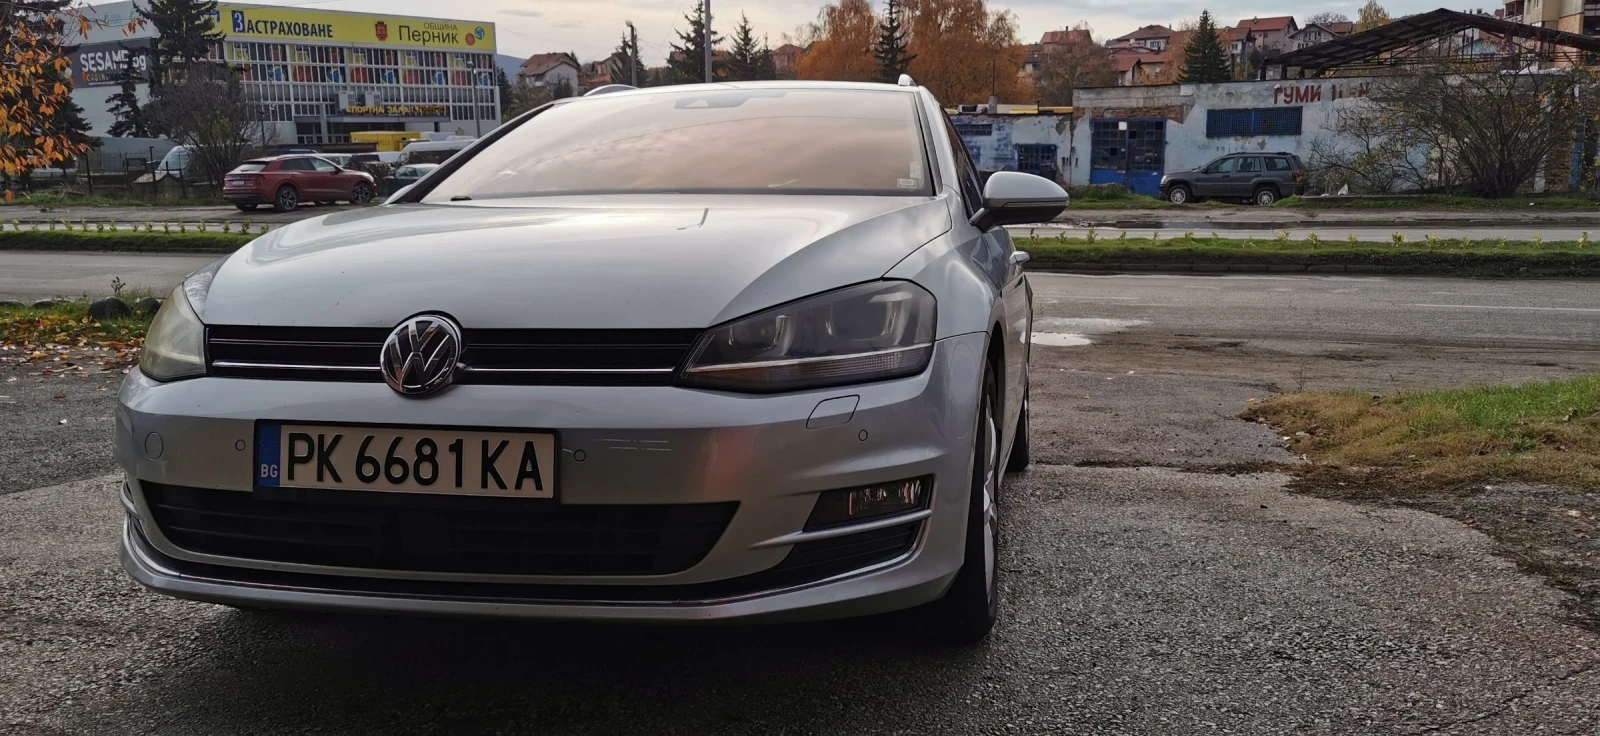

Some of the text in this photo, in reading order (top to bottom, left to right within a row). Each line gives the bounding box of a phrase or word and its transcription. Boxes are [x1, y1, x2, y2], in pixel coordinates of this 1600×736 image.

[232, 10, 333, 38] ЗАСТРАХОВАНЕ
[424, 22, 458, 31] ОБЩИНА
[399, 25, 459, 46] Перник
[1273, 85, 1321, 104] ГУМИ
[260, 464, 278, 478] BG
[288, 432, 543, 491] PK 6681 KA
